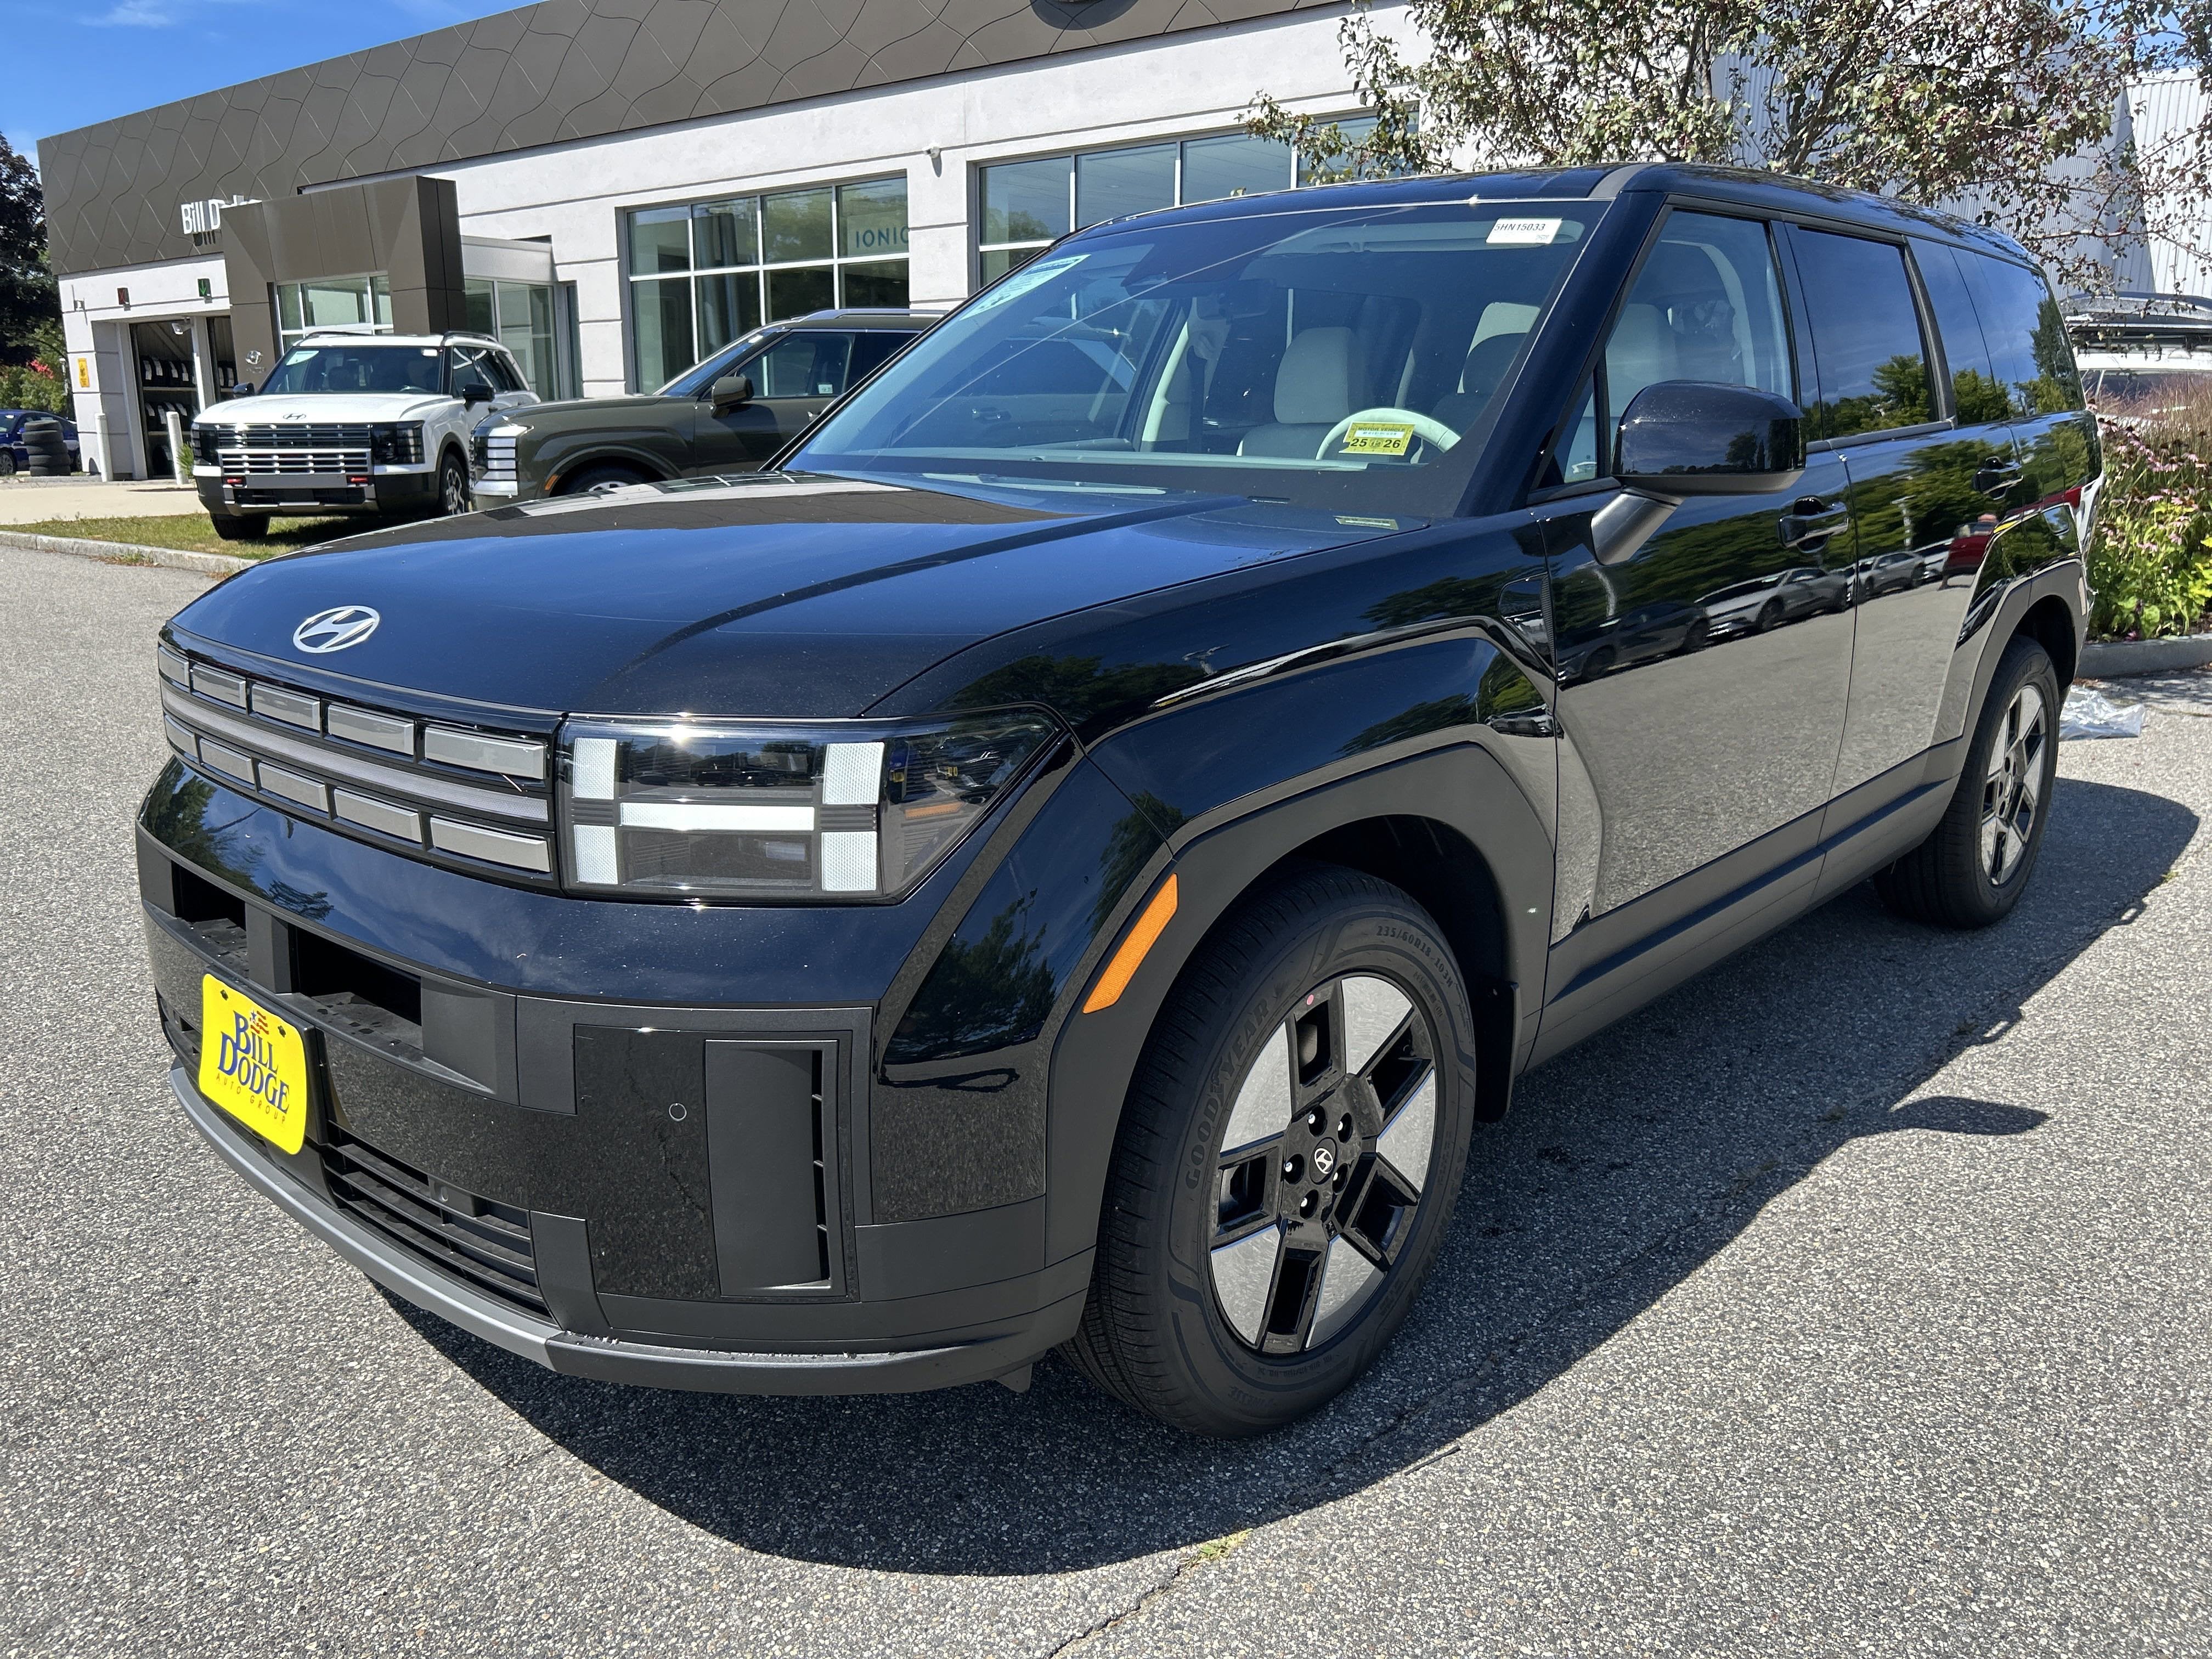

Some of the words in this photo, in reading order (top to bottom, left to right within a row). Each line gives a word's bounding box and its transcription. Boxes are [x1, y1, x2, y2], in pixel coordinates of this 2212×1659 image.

[180, 201, 205, 234] Bill
[1350, 438, 1368, 447] 25
[1384, 439, 1401, 448] 26
[1376, 926, 1431, 957] 235/60R18
[234, 1011, 278, 1074] BILL
[218, 1032, 290, 1114] DODGE
[1185, 998, 1269, 1189] GOODYEAR
[216, 1073, 242, 1094] AUTO
[250, 1095, 286, 1124] GROUP
